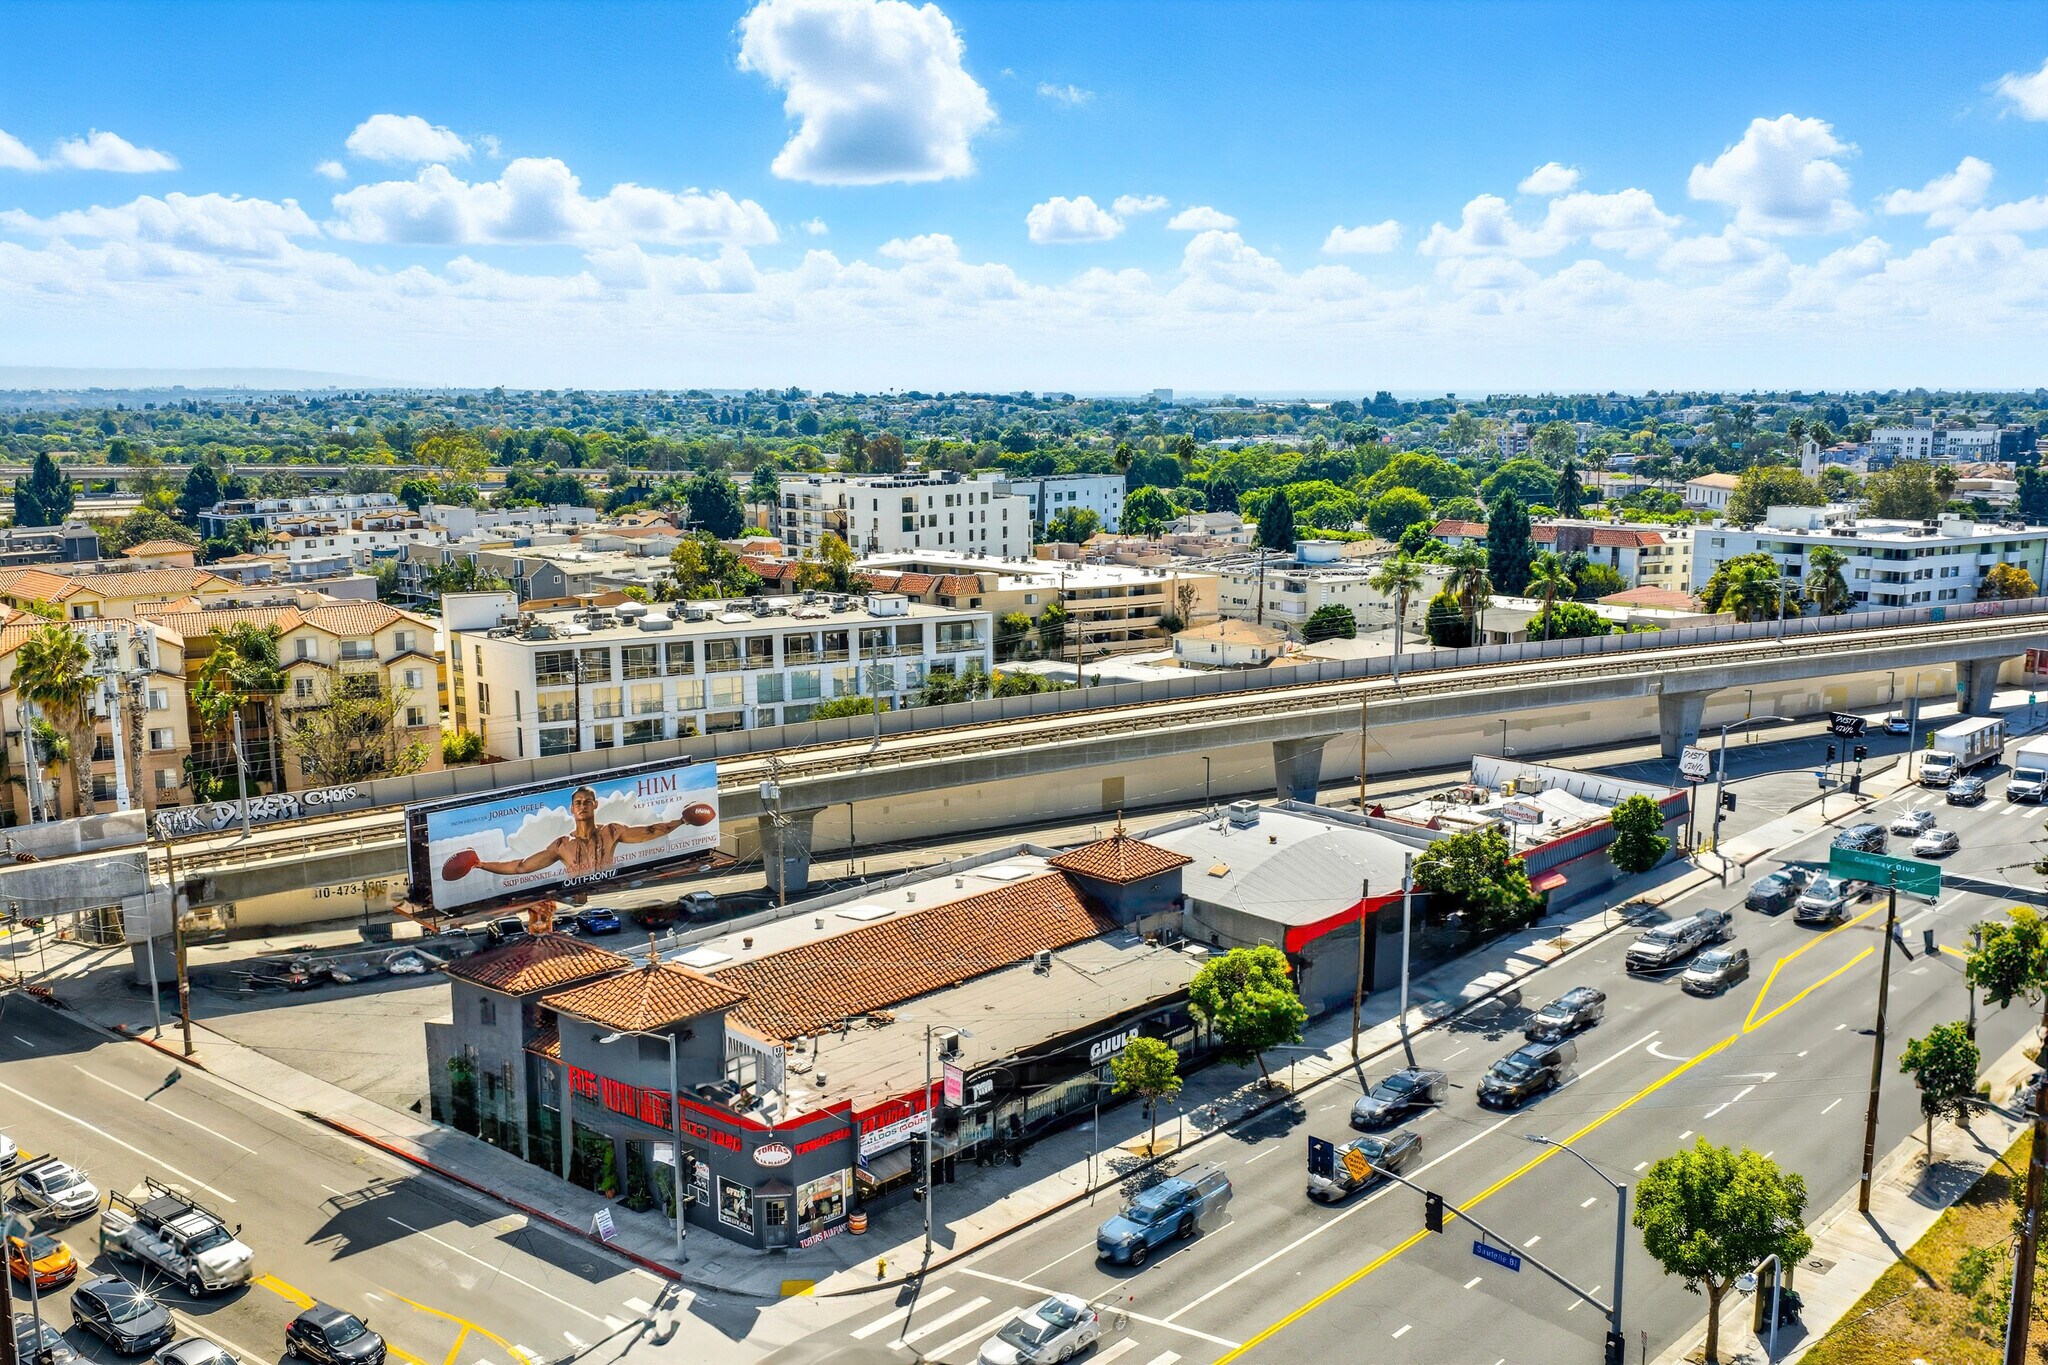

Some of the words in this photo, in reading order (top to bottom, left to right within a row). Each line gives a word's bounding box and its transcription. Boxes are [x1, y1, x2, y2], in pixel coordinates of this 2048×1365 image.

[1835, 714, 1858, 726] DUSTY
[1835, 724, 1854, 734] VINYL
[1683, 750, 1708, 762] DUSTY
[1684, 762, 1704, 772] VINYL
[637, 774, 676, 797] HIM
[302, 786, 359, 806] CHOPS
[633, 796, 674, 809] SEPTEMBER
[488, 806, 520, 821] JORDAN
[667, 840, 691, 852] JUSTIN
[691, 835, 717, 846] TIPPING
[1896, 864, 1916, 873] Blvd
[860, 1128, 897, 1146] ALDOS
[757, 1144, 789, 1156] TORTAS
[1509, 1258, 1518, 1268] Bl
